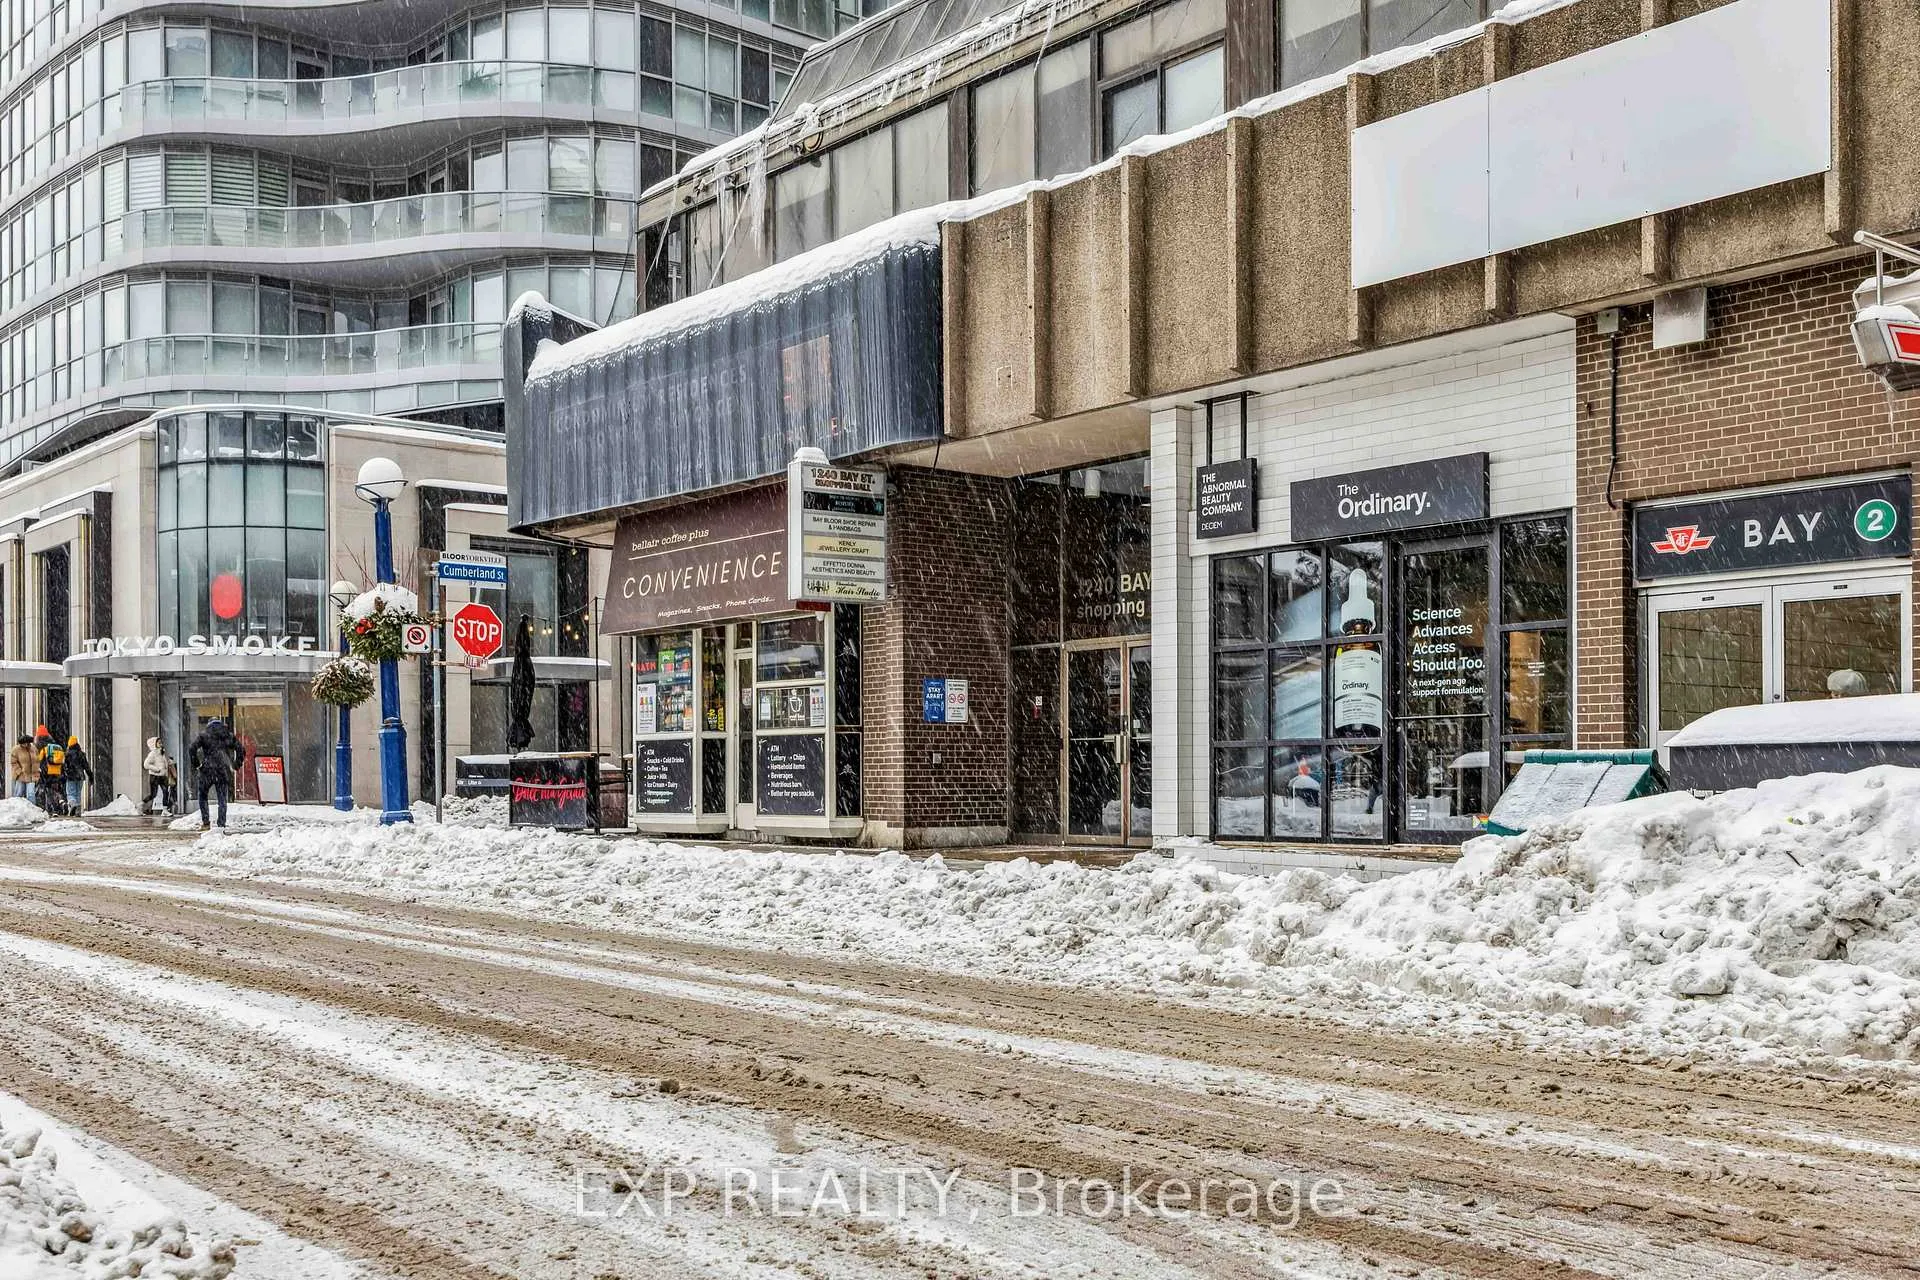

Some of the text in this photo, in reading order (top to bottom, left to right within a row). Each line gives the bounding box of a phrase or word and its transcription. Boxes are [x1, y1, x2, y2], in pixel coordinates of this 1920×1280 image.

[811, 468, 875, 484] 1240 BAY ST.
[1201, 473, 1216, 483] THE
[1201, 479, 1247, 494] ABNORMAL
[1337, 484, 1359, 497] The
[1201, 492, 1231, 505] BEAUTY
[1338, 490, 1431, 519] Ordinary.
[1201, 502, 1243, 516] COMPANY.
[1867, 509, 1884, 531] 2
[1743, 511, 1823, 548] BAY
[631, 528, 709, 552] bellair coffee plus
[443, 564, 504, 580] Cumberland St
[623, 551, 782, 599] CONVENIENCE
[1120, 571, 1152, 593] BAY
[1076, 598, 1145, 621] shopping
[1412, 607, 1461, 621] Science
[456, 618, 499, 643] STOP
[1412, 624, 1473, 638] Advances
[83, 634, 317, 658] TOKYO SMOKE
[1412, 642, 1456, 655] Access
[1412, 657, 1486, 672] Should Too.
[1419, 678, 1451, 688] next-gen
[1452, 678, 1467, 687] age
[1412, 686, 1486, 698] support formulation.
[771, 772, 793, 780] Beverages
